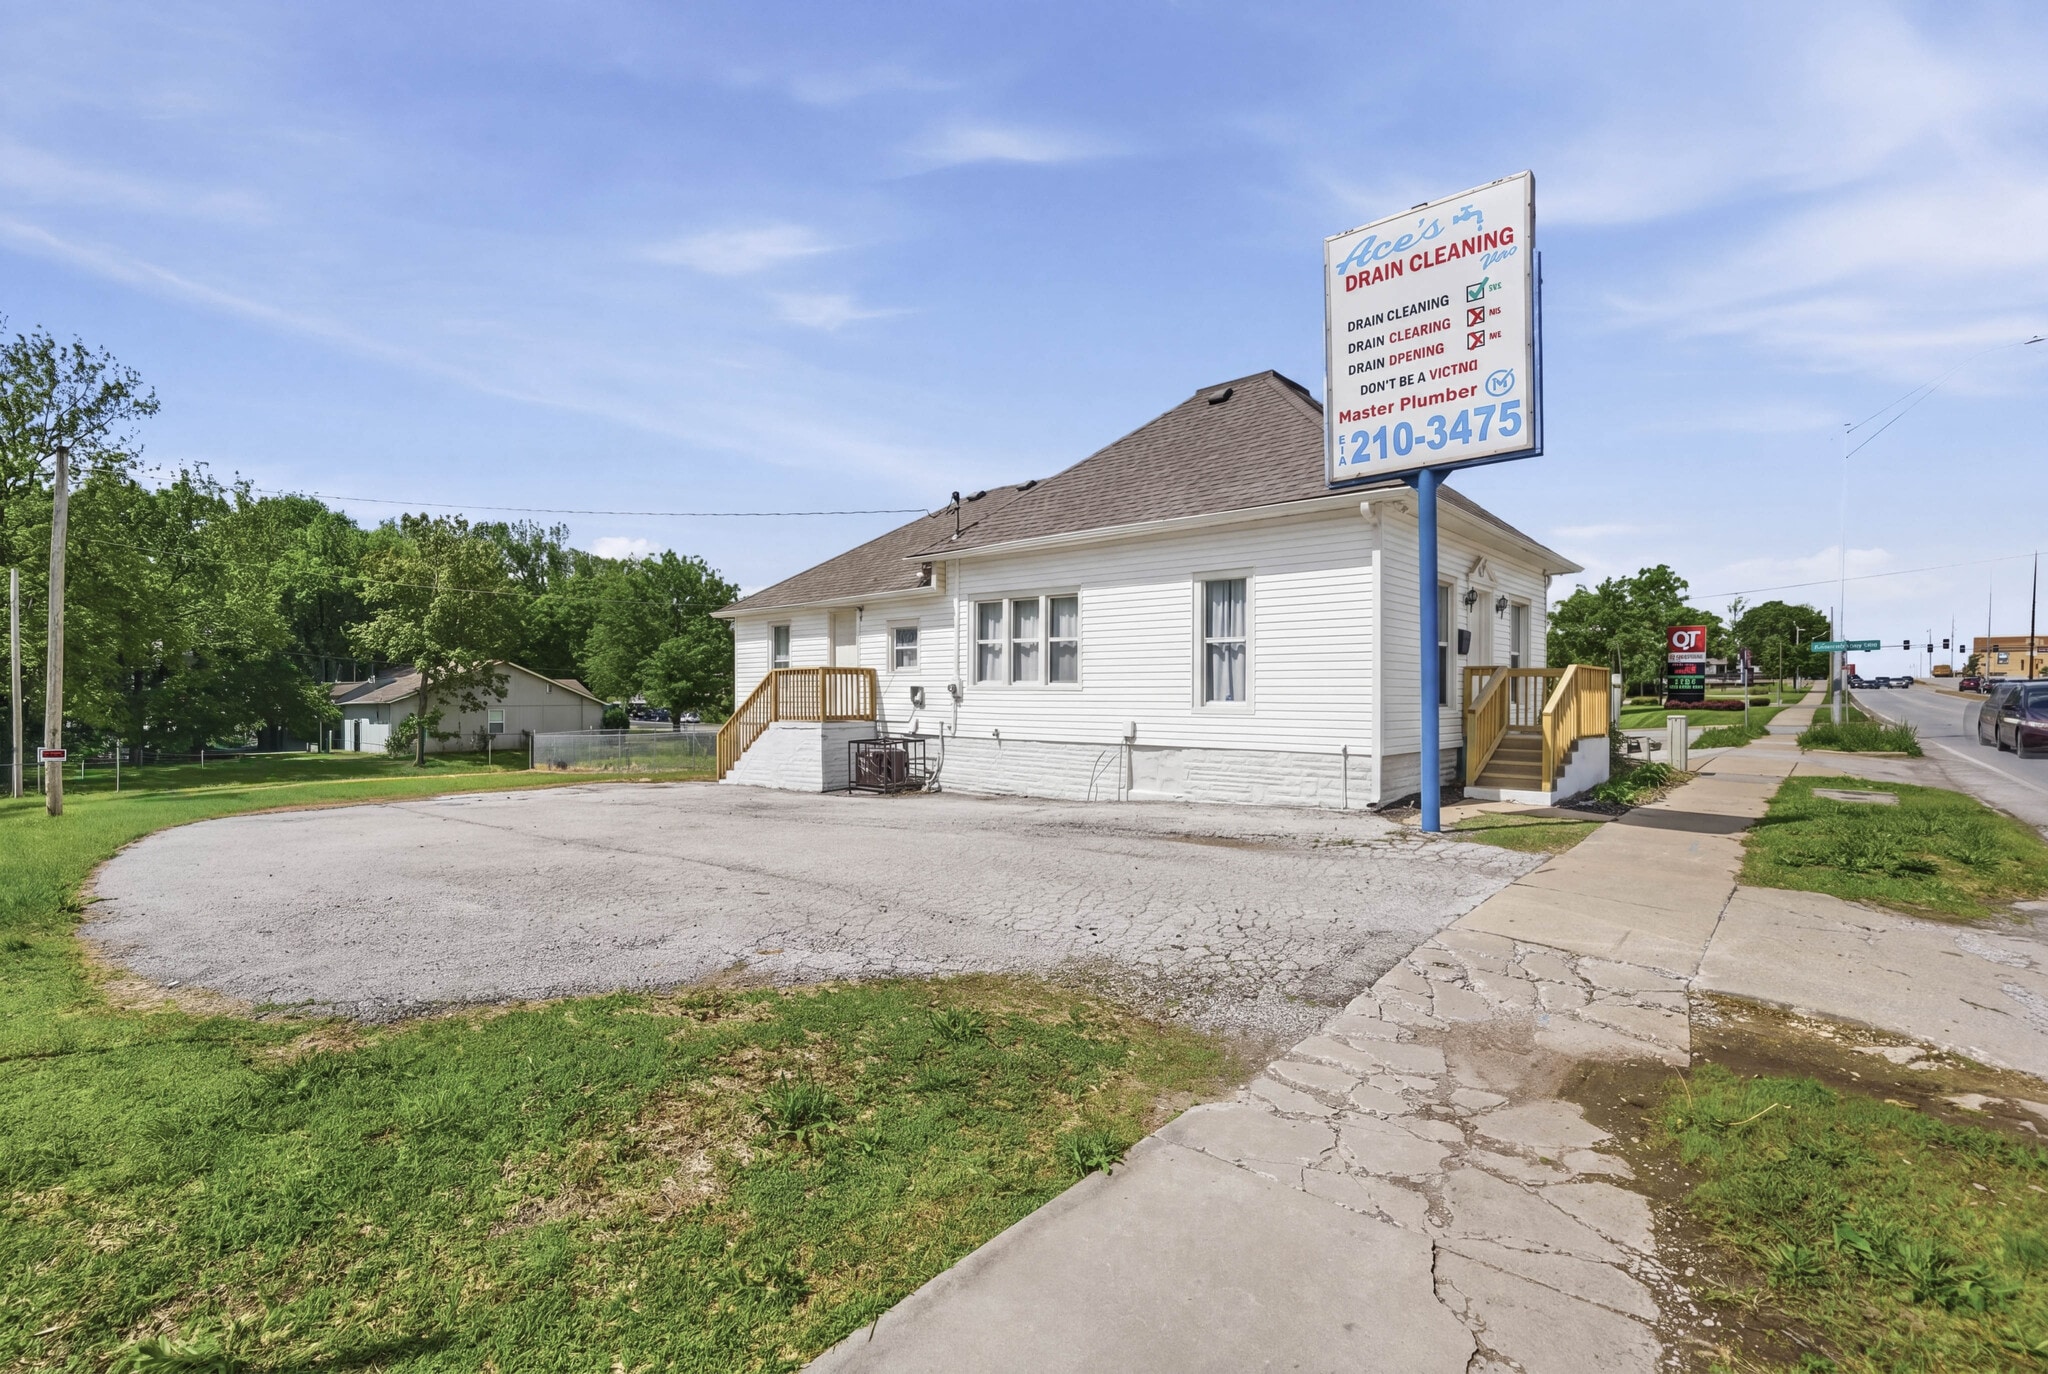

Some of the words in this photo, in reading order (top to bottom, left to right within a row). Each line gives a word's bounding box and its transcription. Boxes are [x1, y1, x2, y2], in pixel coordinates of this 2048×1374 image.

[1336, 217, 1445, 275] Ace's
[1345, 259, 1403, 292] DRAIN
[1409, 226, 1514, 272] CLEANING
[1347, 312, 1384, 332] DRAIN
[1387, 295, 1450, 321] CLEANING
[1348, 335, 1385, 354] DRAIN
[1389, 318, 1451, 344] CLEARING
[1348, 357, 1385, 376] DRAIN
[1360, 378, 1396, 396] DON'T
[1399, 374, 1415, 388] BE
[1417, 371, 1426, 384] A
[1339, 402, 1394, 424] Master
[1400, 385, 1478, 412] Plumber
[1350, 399, 1522, 465] 210-3475
[1672, 630, 1702, 651] QT
